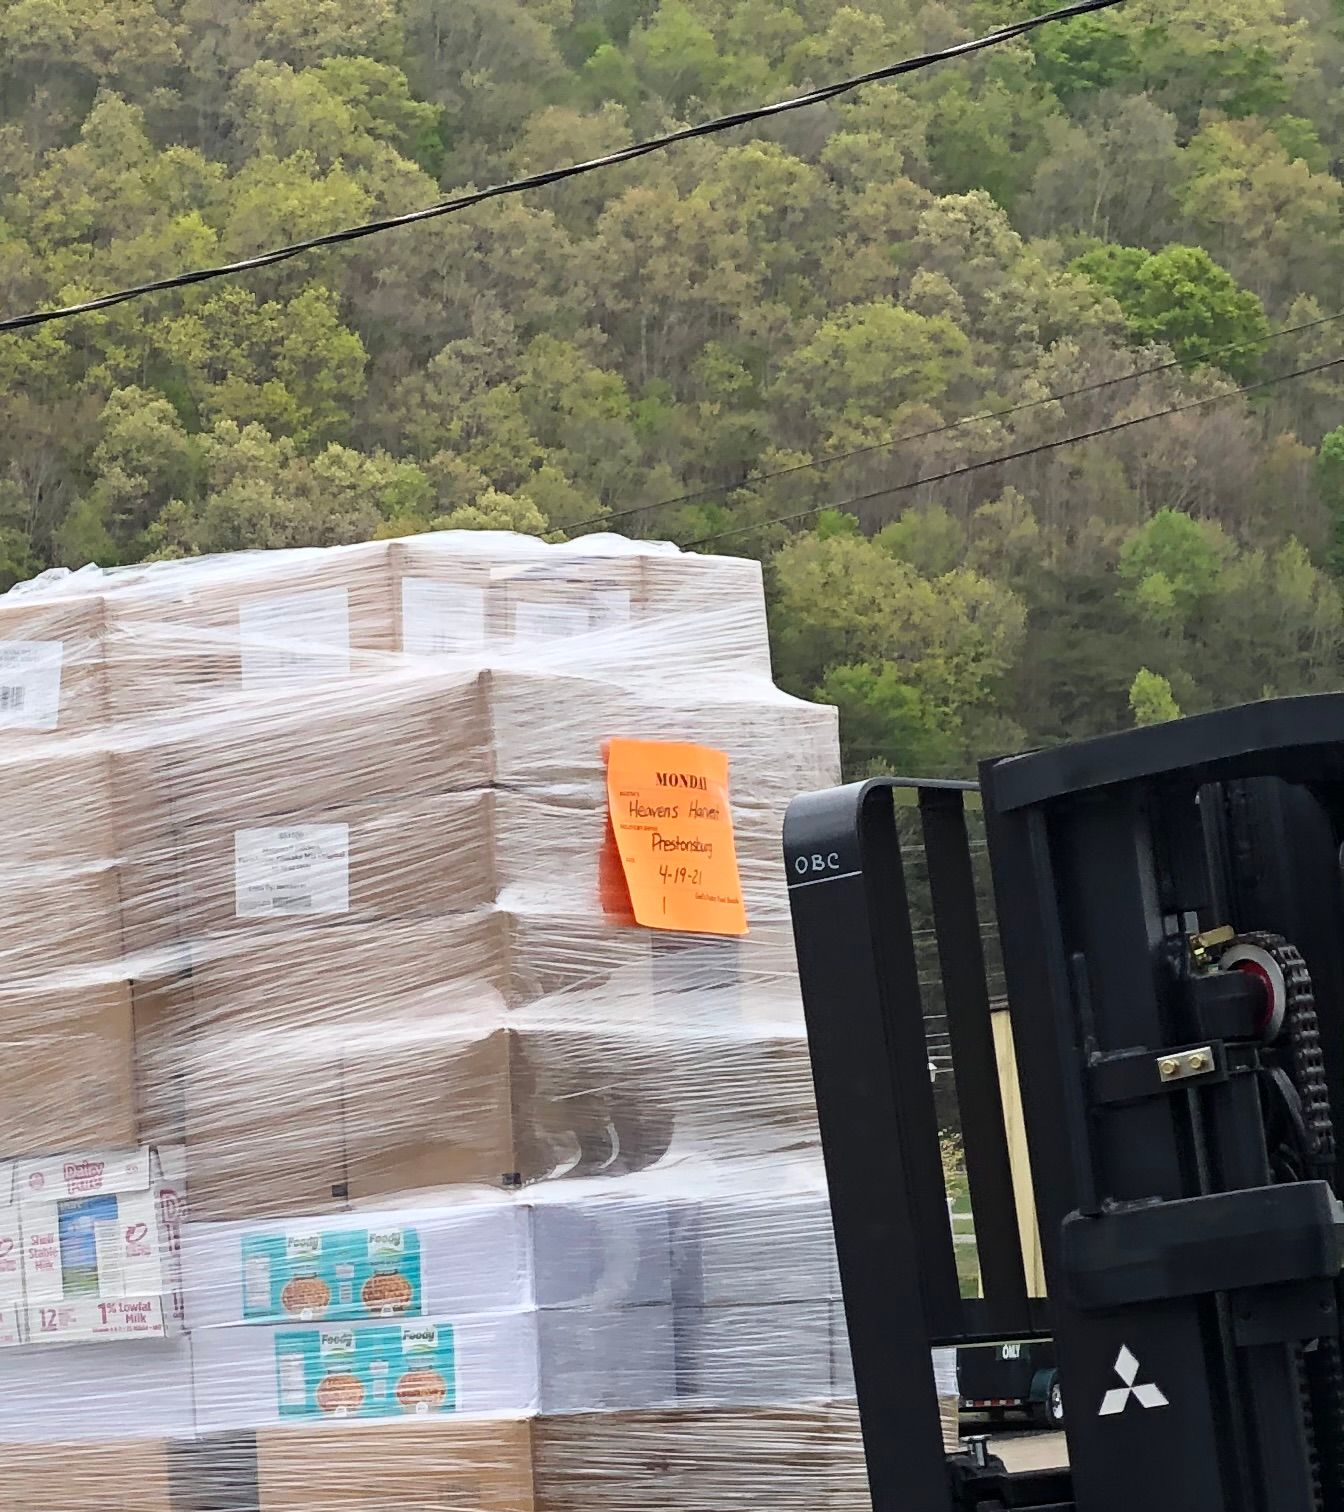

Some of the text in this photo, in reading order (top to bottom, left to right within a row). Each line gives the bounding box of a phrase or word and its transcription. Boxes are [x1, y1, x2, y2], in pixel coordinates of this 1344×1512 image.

[629, 800, 678, 819] Heavens
[795, 852, 840, 874] OBC
[659, 865, 702, 885] 4-19-21
[63, 1160, 105, 1180] Dairy
[40, 1309, 57, 1328] 12
[97, 1302, 117, 1325] 1%
[118, 1302, 151, 1313] Lowfat
[126, 1313, 147, 1323] Milk
[1002, 1344, 1021, 1360] ONLY
